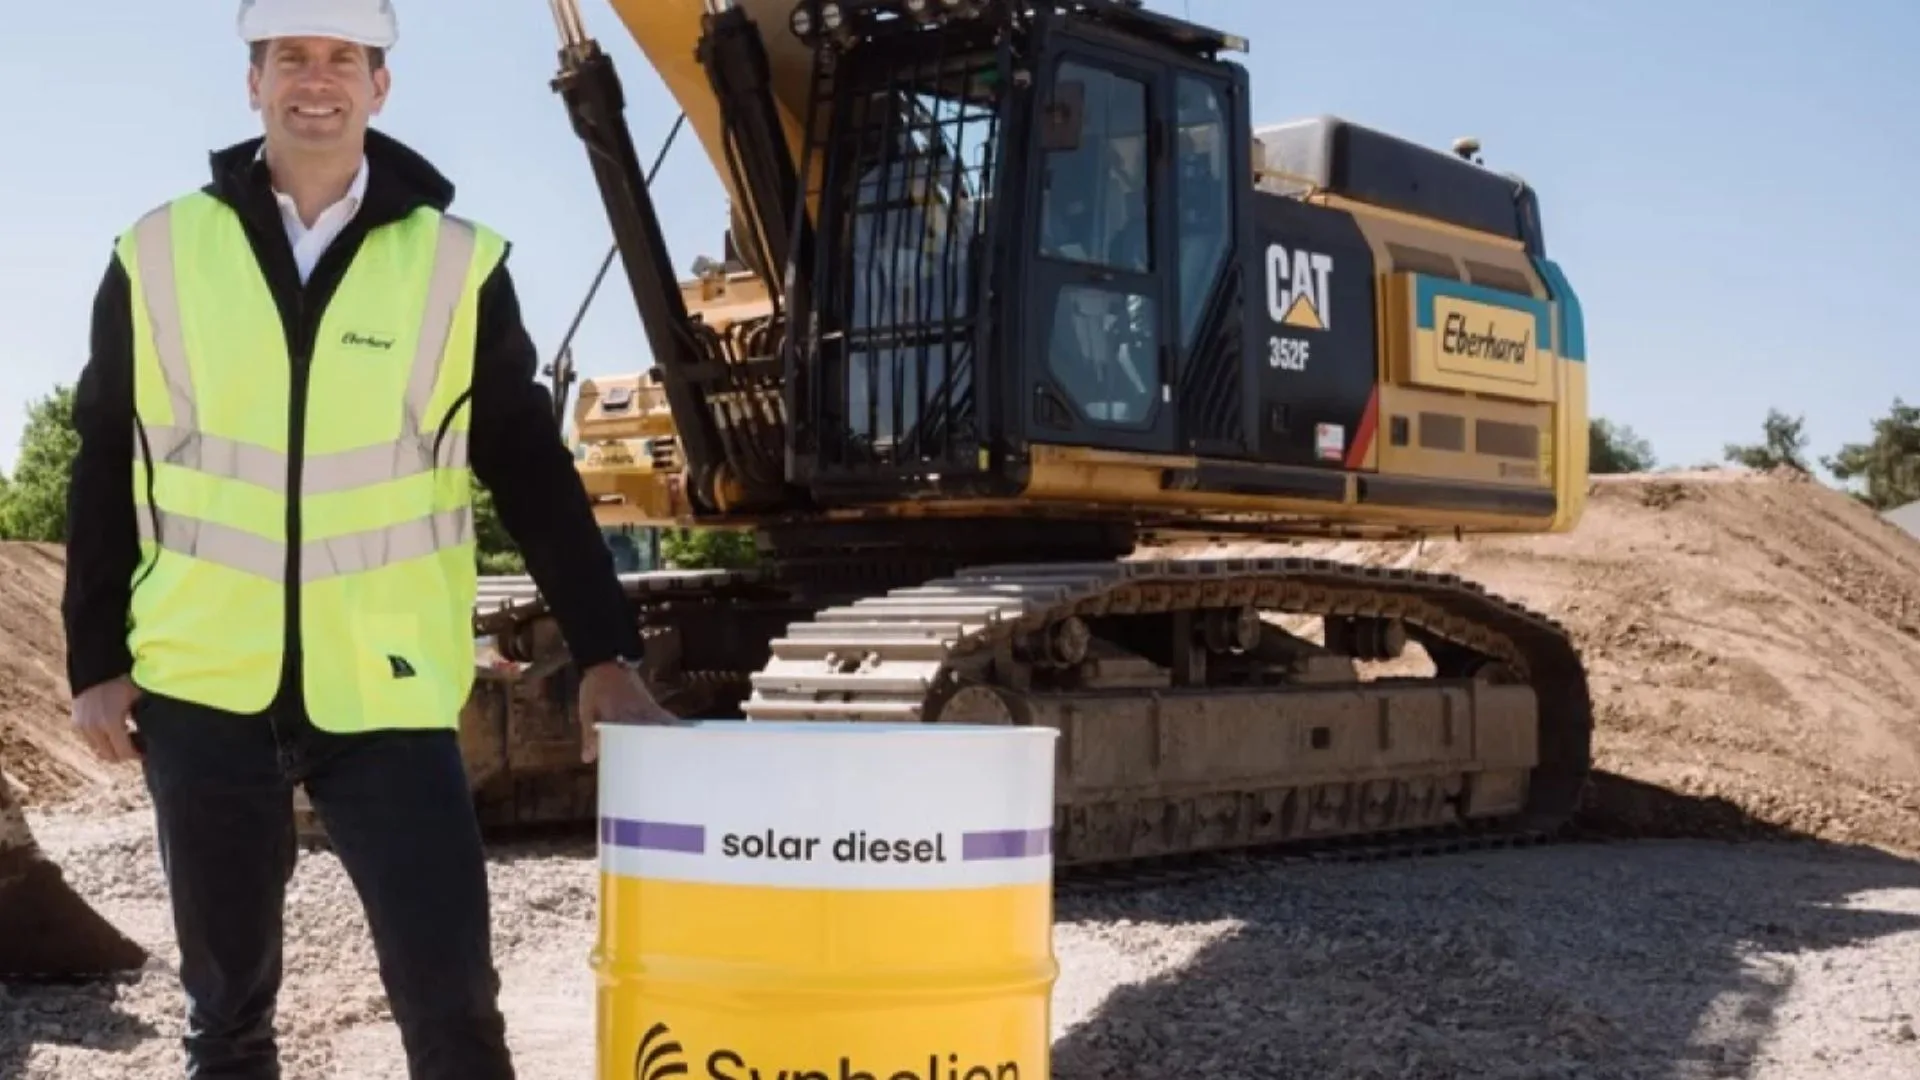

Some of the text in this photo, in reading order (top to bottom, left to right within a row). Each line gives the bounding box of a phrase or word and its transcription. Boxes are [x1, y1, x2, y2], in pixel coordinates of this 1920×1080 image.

[1265, 244, 1333, 331] CAT
[1269, 336, 1309, 370] 352F
[1443, 312, 1530, 364] Eberhard
[722, 828, 946, 863] solar diesel
